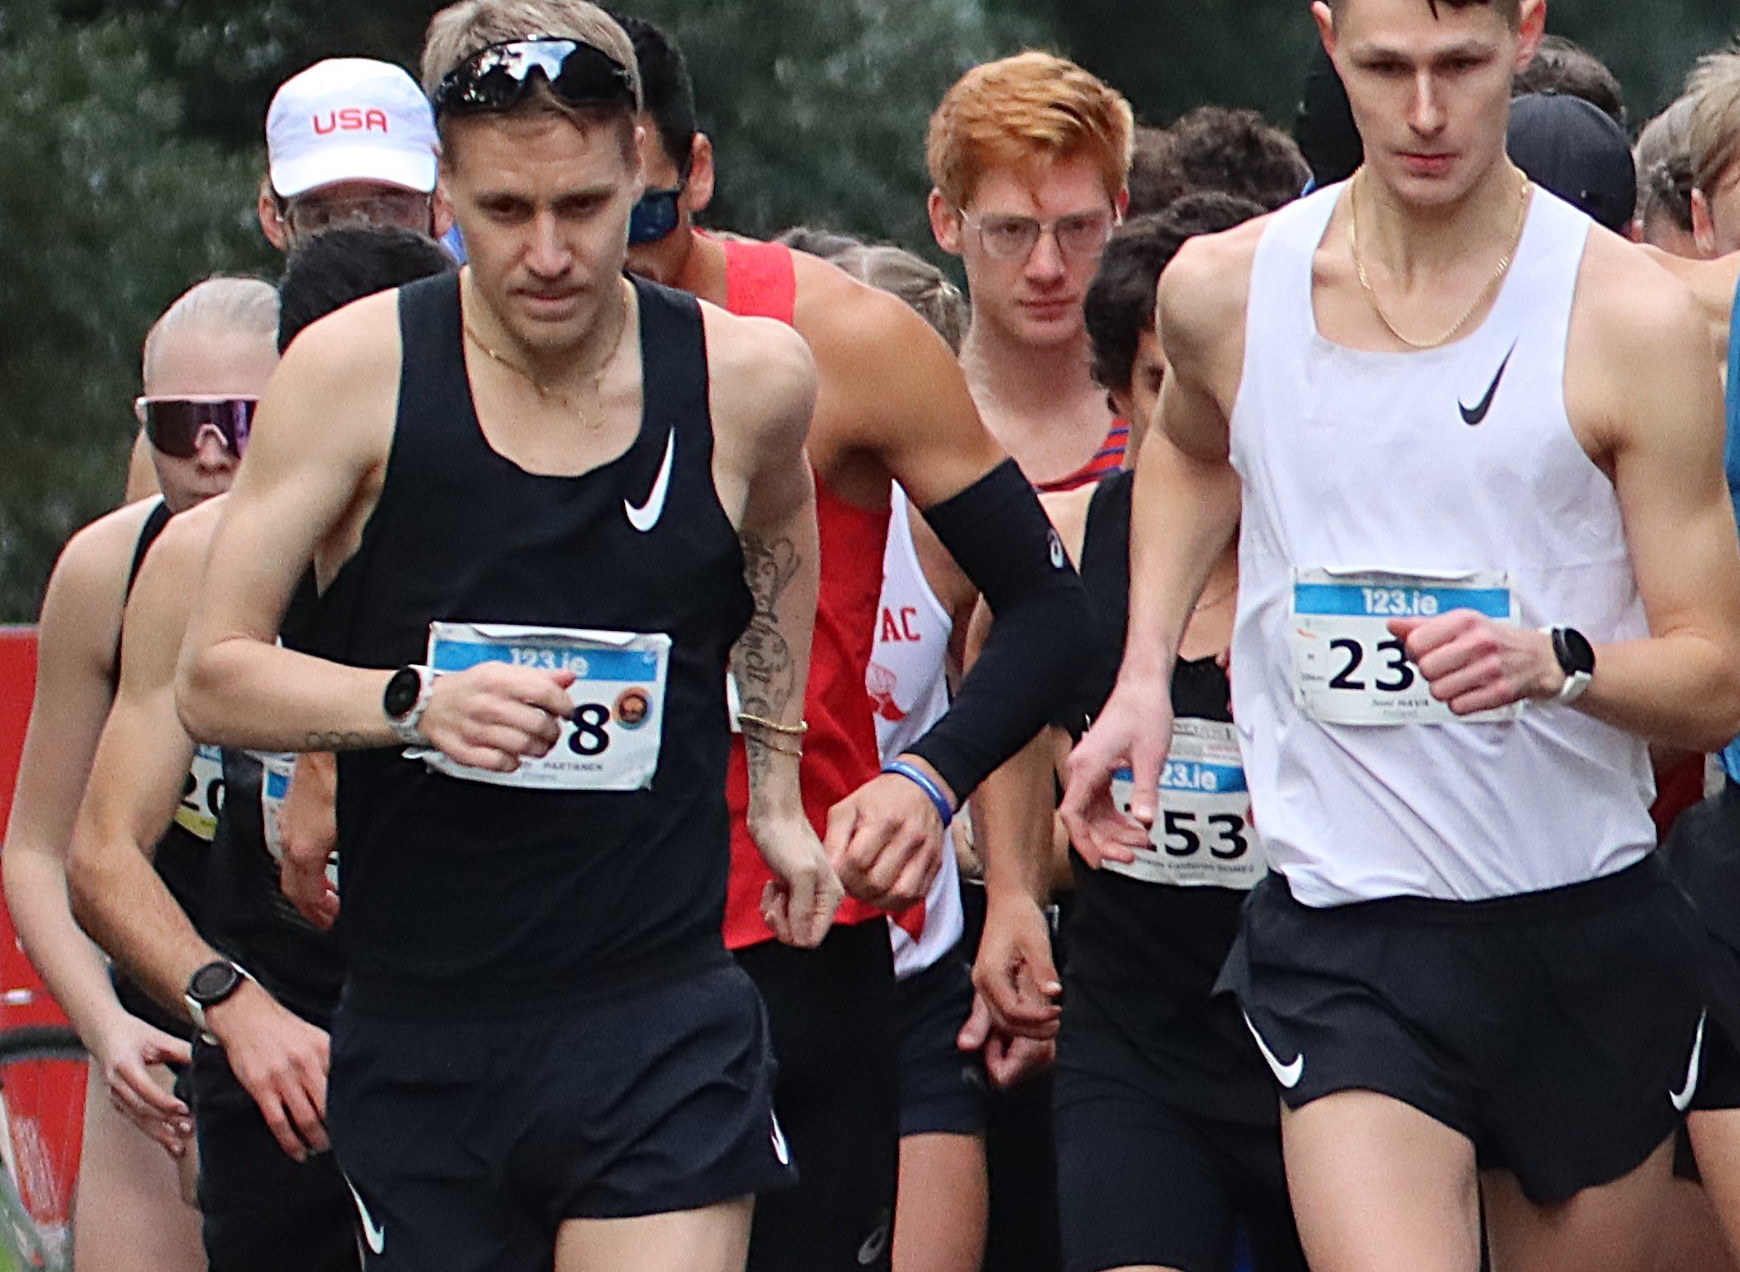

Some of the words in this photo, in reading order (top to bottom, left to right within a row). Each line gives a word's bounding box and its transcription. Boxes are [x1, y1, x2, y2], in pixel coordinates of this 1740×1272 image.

[312, 108, 389, 136] USA
[1361, 586, 1439, 616] 123.ie
[1328, 637, 1415, 693] 23
[1158, 762, 1218, 791] 23.ie
[1146, 809, 1248, 861] 53
